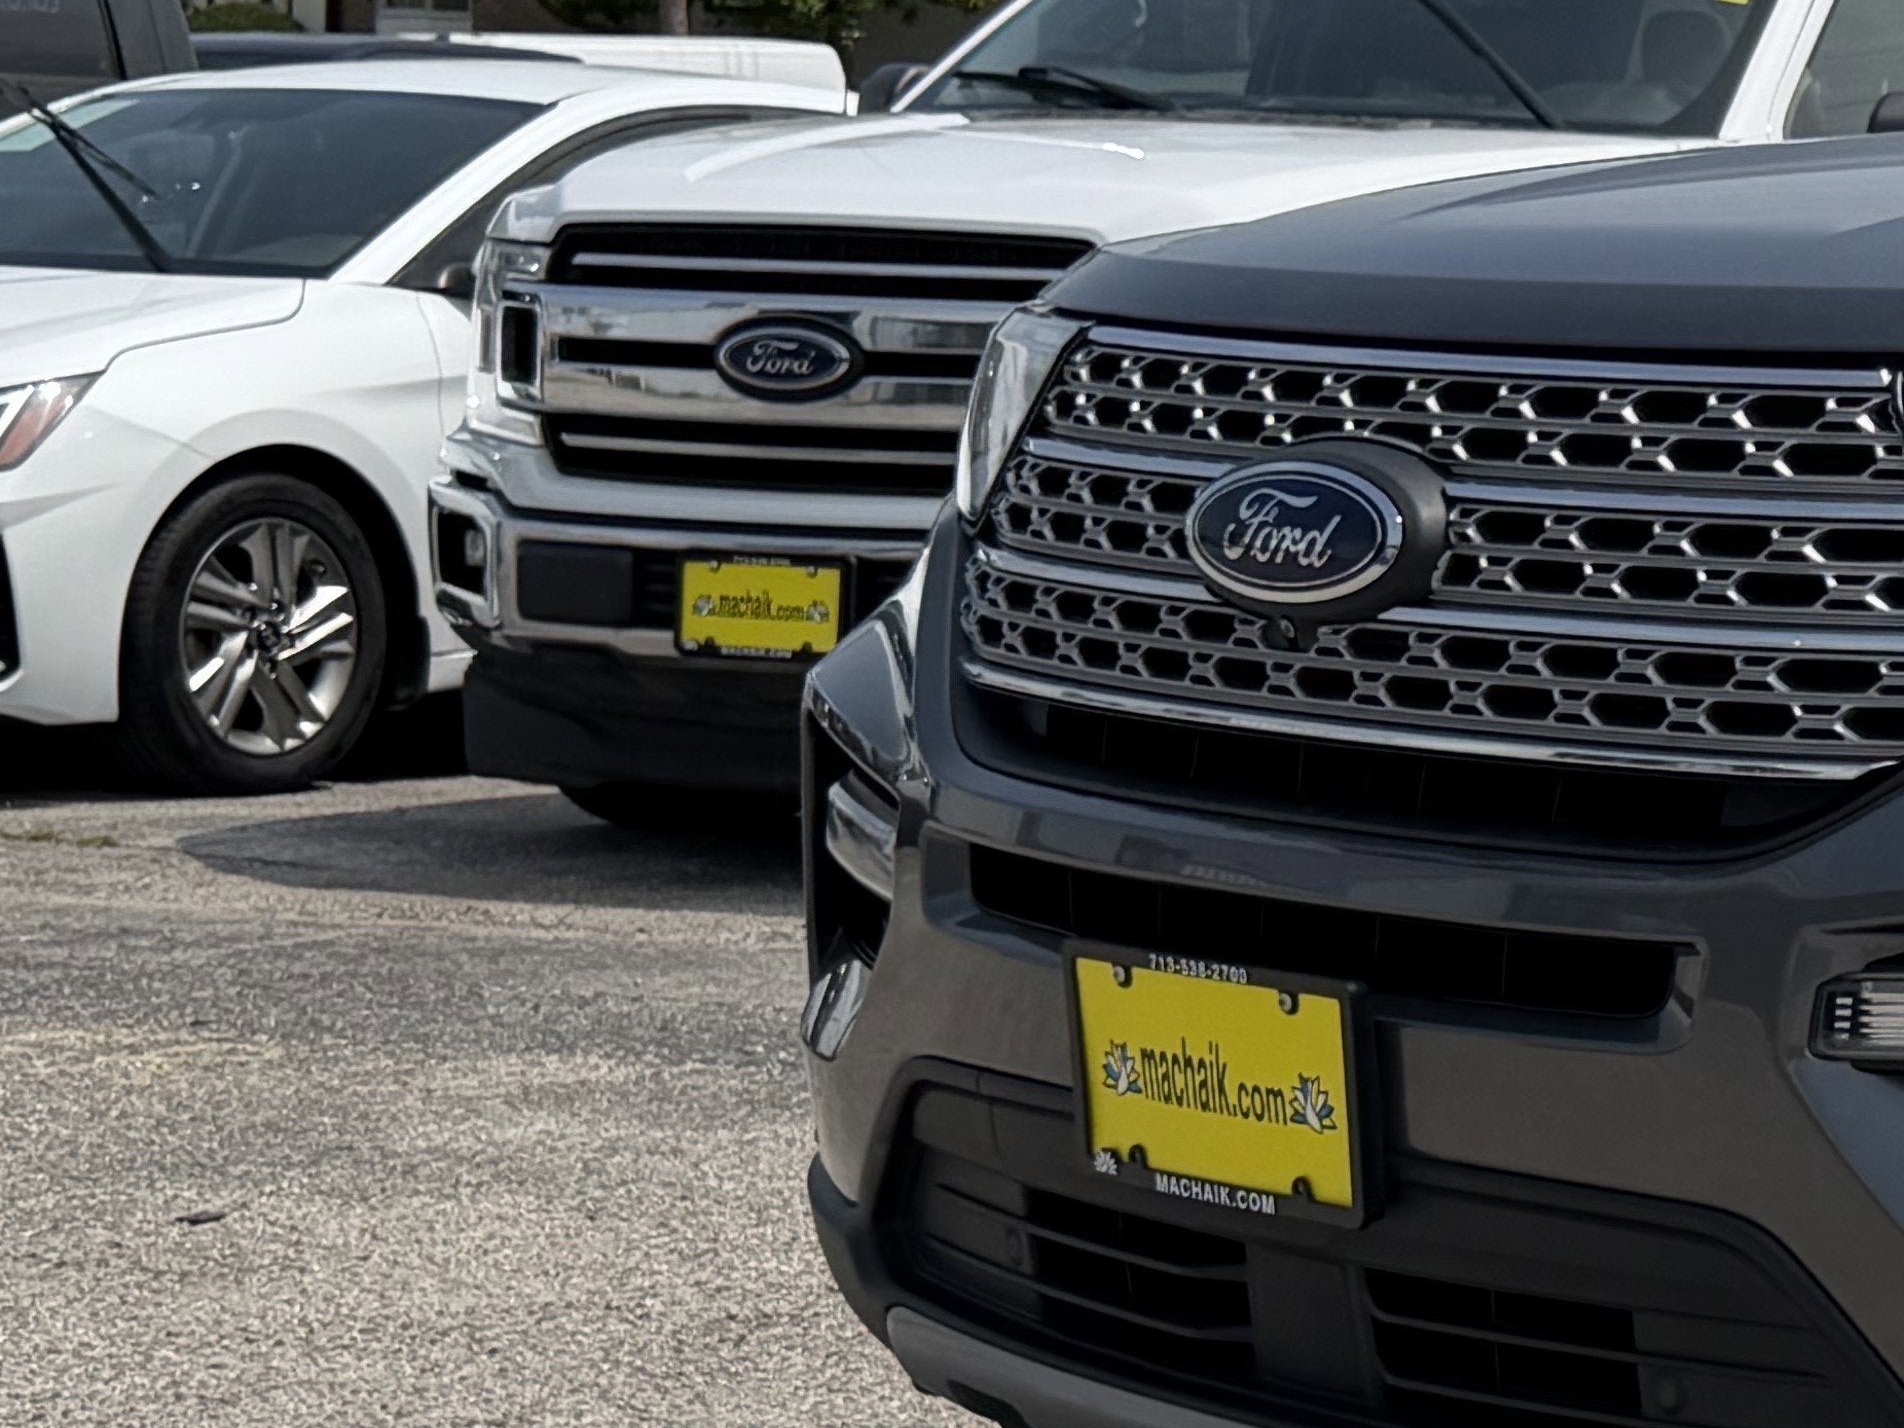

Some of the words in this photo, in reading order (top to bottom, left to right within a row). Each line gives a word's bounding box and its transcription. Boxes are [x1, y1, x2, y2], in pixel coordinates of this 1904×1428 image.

[745, 340, 815, 376] Ford
[1223, 487, 1342, 568] Ford
[1140, 1036, 1288, 1126] machaik.com
[1155, 1173, 1276, 1215] MACHAIK.COM
